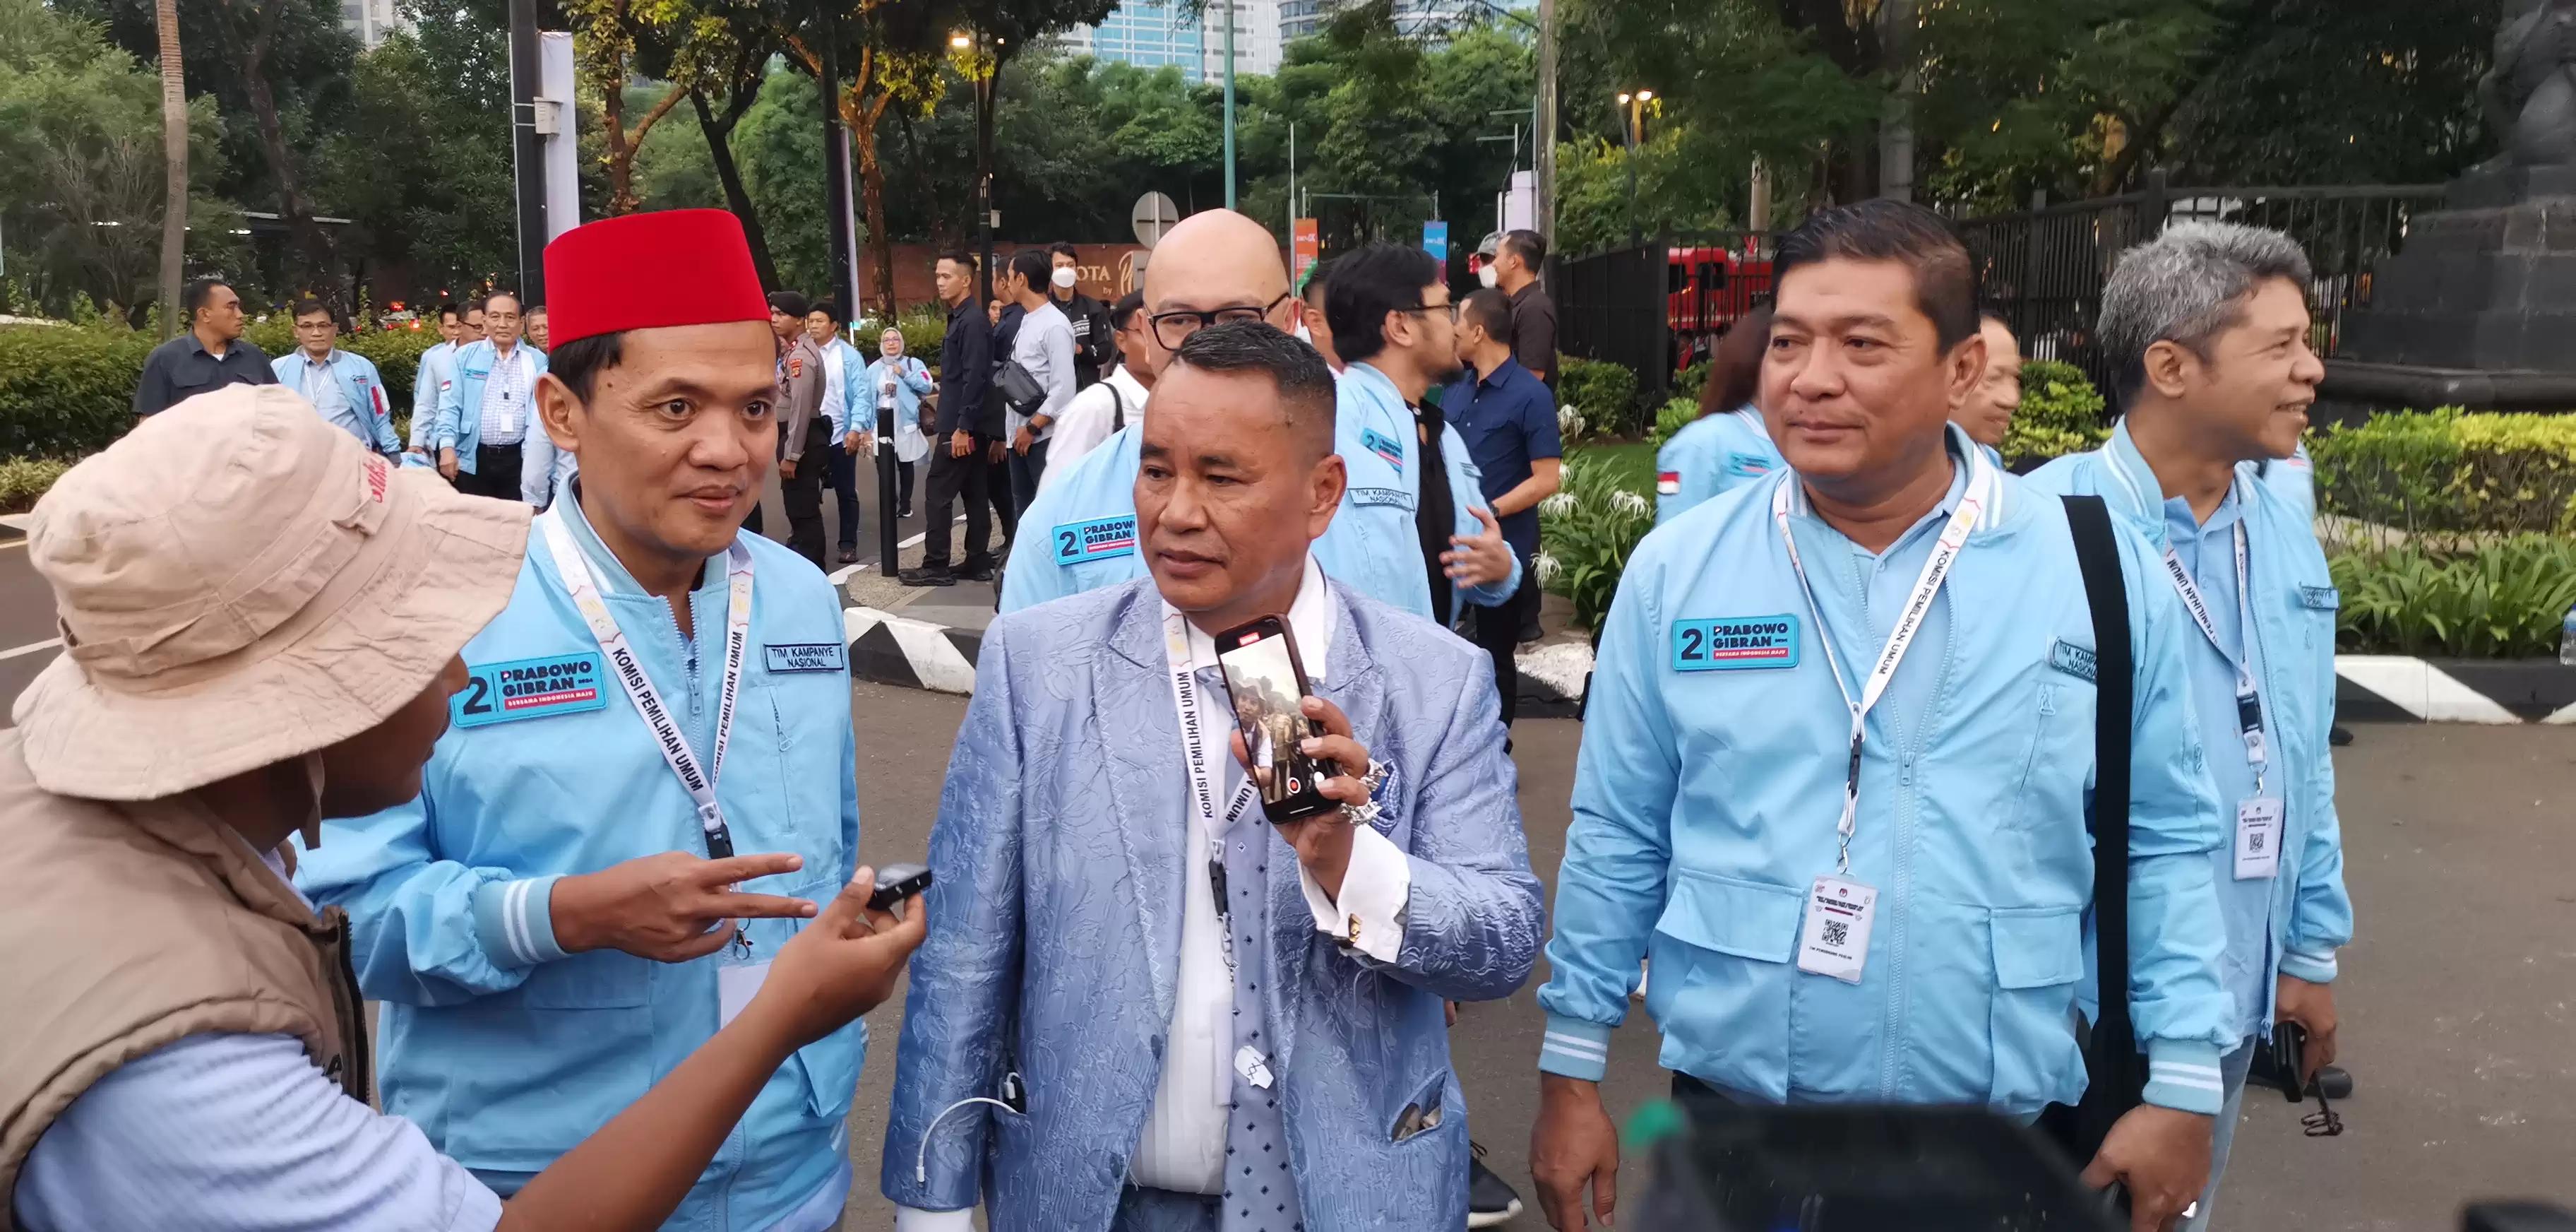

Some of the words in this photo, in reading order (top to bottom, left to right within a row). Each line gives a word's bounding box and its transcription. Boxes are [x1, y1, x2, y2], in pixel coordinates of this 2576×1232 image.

[1076, 266, 1111, 281] OTA
[1103, 287, 1113, 295] by
[1084, 520, 1135, 535] PRABOW
[1085, 530, 1131, 544] GIBRAN
[1059, 531, 1079, 557] 2
[1926, 550, 1951, 586] KOMISI
[2166, 558, 2189, 588] UMUM
[2183, 586, 2214, 634] PEMILIHAN
[1896, 588, 1932, 641] PEMILIHAN
[1713, 622, 1789, 636] PRABOWO
[1713, 636, 1772, 648] GIBRAN
[771, 648, 788, 658] TIM
[791, 647, 834, 657] KAMPANYE
[1681, 628, 1703, 660] 2
[500, 661, 592, 683] PRABOWO
[787, 658, 826, 668] NASIONAL
[1878, 644, 1901, 675] UMUM
[463, 676, 492, 715] 2
[502, 677, 575, 697] GIBRAN
[720, 671, 737, 738] PEMILIHAN
[729, 631, 744, 668] UMUM
[1177, 671, 1194, 707] UMUM
[508, 697, 538, 706] BERSAMA
[539, 693, 576, 702] INDONESIA
[612, 647, 647, 692] KOMISI
[637, 690, 683, 756] PEMILIHAN
[675, 748, 704, 792] UMUM
[1184, 711, 1206, 774] PEMILIHAN
[1196, 777, 1213, 818] KOMISI
[1225, 788, 1252, 823] UMUM
